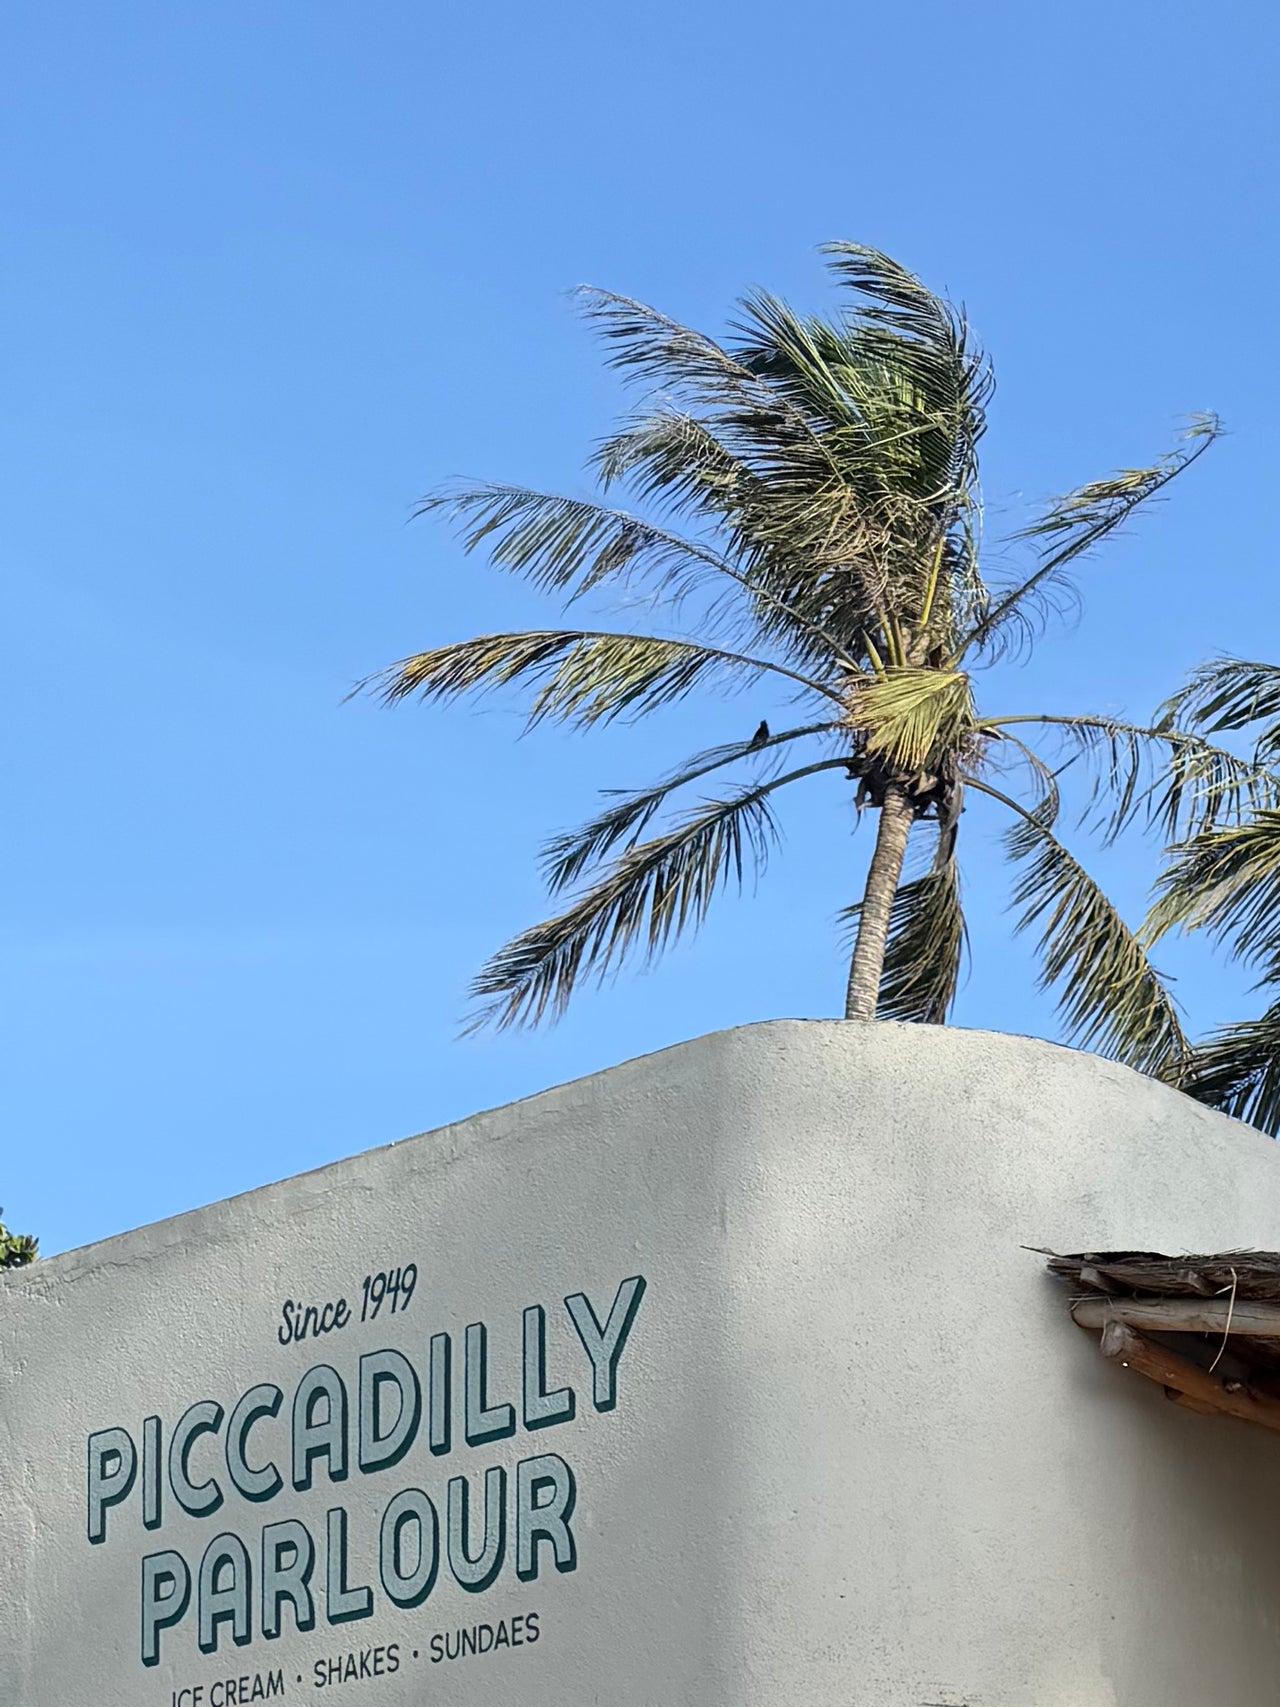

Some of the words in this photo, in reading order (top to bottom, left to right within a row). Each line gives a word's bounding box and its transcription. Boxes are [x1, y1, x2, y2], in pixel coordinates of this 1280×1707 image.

[277, 1298, 352, 1346] Since
[359, 1263, 418, 1323] 1949
[87, 1274, 648, 1546] PICCADILLY
[140, 1452, 578, 1667] PARLOUR
[312, 1643, 401, 1689] SHAKES
[429, 1612, 541, 1665] SUNDAES
